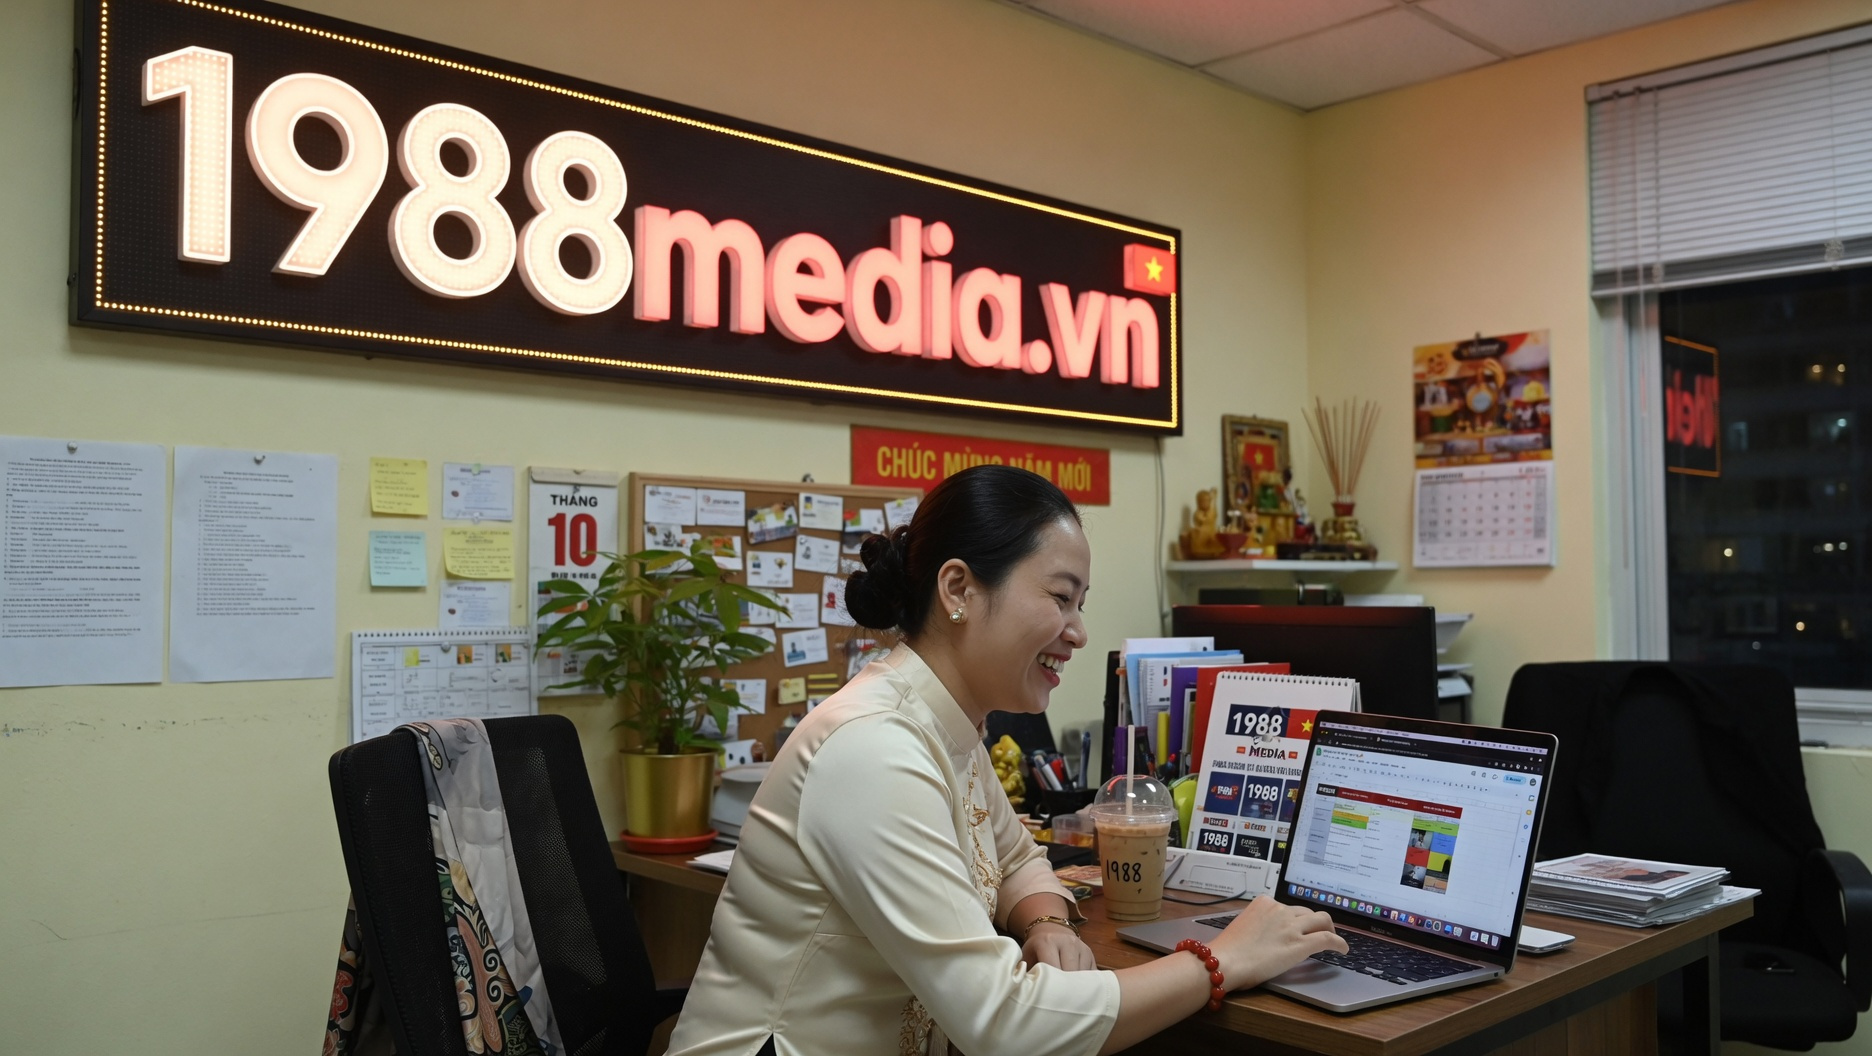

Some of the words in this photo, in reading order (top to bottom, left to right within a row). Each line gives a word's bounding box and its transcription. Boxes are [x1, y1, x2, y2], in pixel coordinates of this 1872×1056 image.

[877, 442, 936, 480] CHÚC
[1058, 457, 1091, 492] MỚI
[548, 512, 597, 567] 10
[1233, 712, 1283, 736] 1988
[1249, 745, 1286, 760] MEDIA
[1248, 783, 1278, 802] 1988
[1203, 832, 1229, 847] 1988
[1106, 859, 1142, 883] 1988
